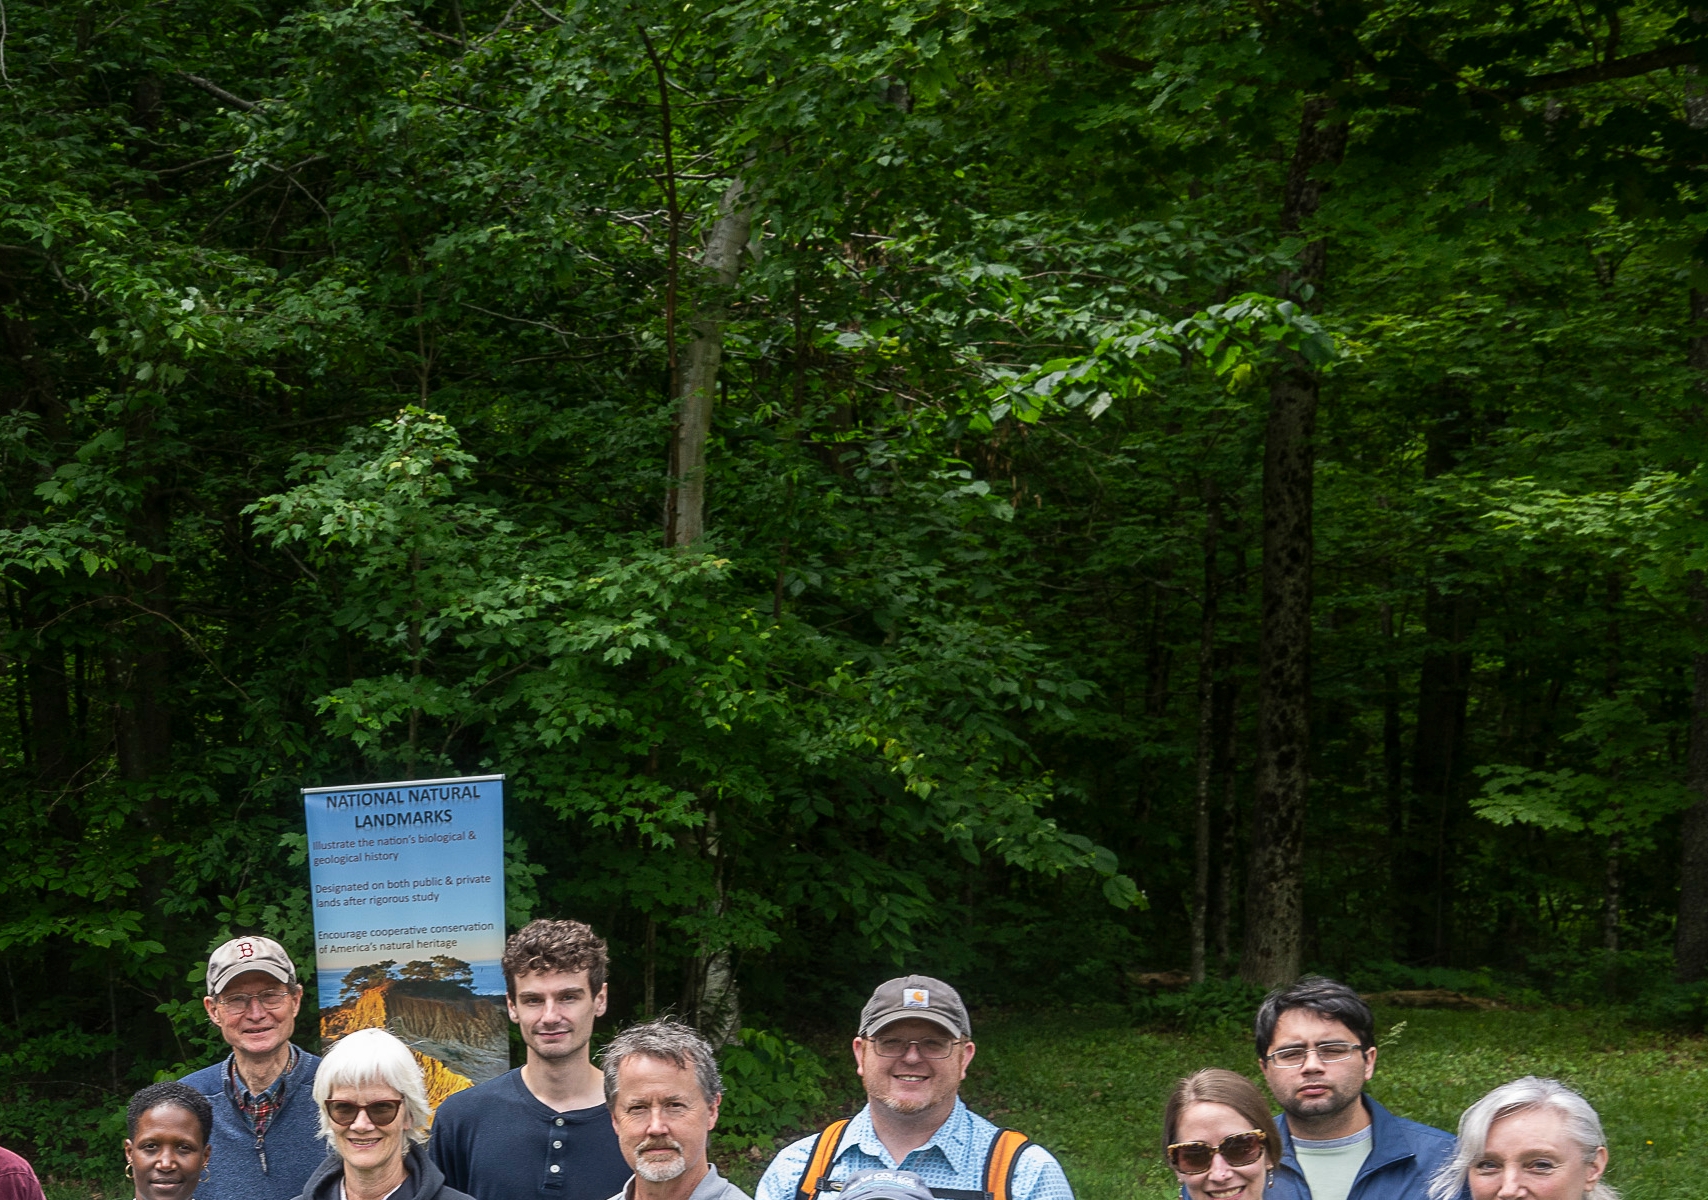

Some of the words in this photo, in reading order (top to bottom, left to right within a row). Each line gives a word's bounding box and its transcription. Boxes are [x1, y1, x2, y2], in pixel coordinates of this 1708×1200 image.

[326, 790, 405, 808] NATIONAL
[408, 785, 481, 803] NATURAL
[354, 809, 453, 828] LANDMARKS
[313, 840, 356, 850] Illustrate
[358, 838, 375, 847] the
[377, 834, 416, 846] nation's
[418, 831, 466, 844] biological
[468, 830, 477, 840] &
[313, 852, 362, 867] geological
[364, 851, 399, 862] history
[315, 881, 369, 894] Designated
[371, 882, 385, 890] on
[387, 879, 410, 889] both
[413, 877, 443, 889] public
[445, 875, 454, 886] &
[456, 874, 491, 886] private
[316, 898, 341, 908] lands
[343, 896, 367, 906] after
[369, 895, 409, 907] rigorous
[411, 891, 440, 903] study
[318, 930, 368, 940] Encourage
[370, 926, 428, 937] cooperative
[430, 921, 494, 934] conservation
[236, 942, 254, 960] B
[319, 944, 329, 954] of
[330, 942, 377, 953] America's
[379, 940, 414, 951] natural
[416, 938, 458, 950] heritage
